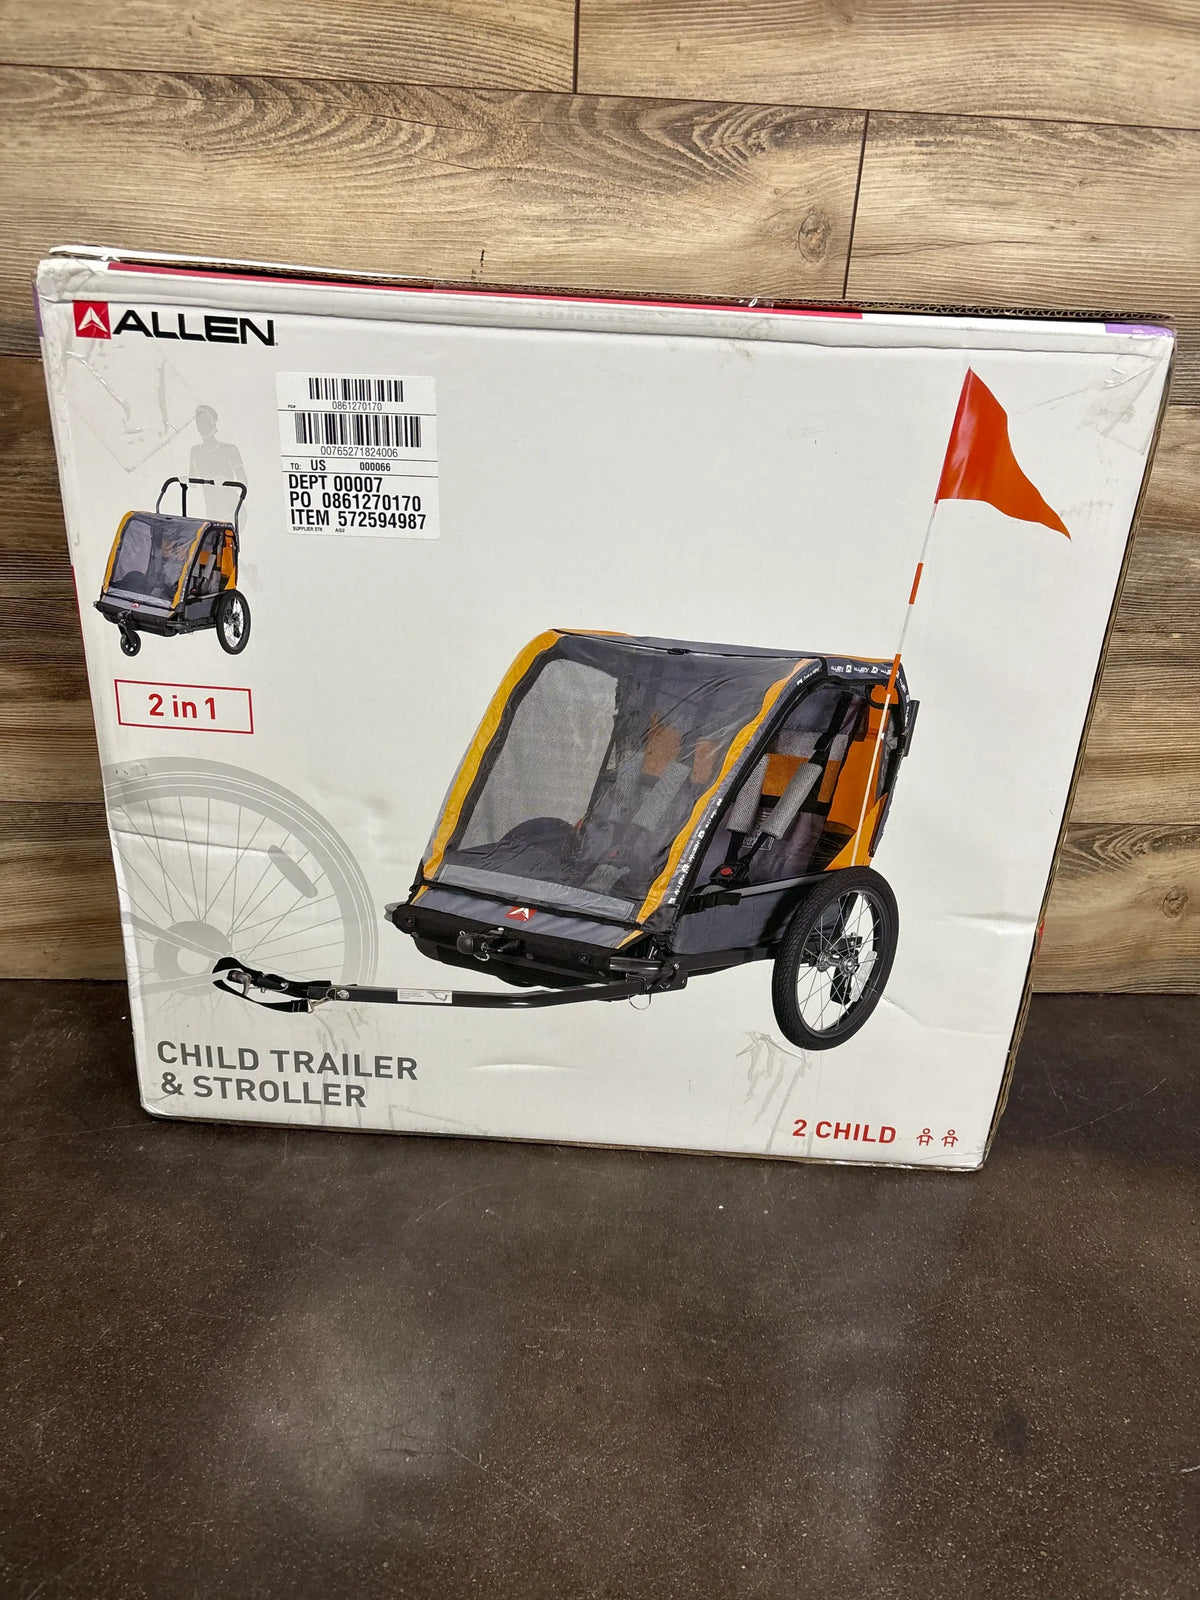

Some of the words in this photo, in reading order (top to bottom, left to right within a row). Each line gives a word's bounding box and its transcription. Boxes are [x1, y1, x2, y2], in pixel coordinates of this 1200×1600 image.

[112, 309, 275, 346] ALLEN
[332, 401, 382, 411] 0861270170
[320, 446, 398, 458] 00765271824006
[290, 462, 302, 470] TO:
[310, 459, 326, 471] US
[360, 462, 391, 472] 000066
[289, 474, 327, 490] DEPT
[333, 475, 383, 493] 00007
[290, 491, 311, 508] PO
[322, 492, 421, 512] 0861270170
[291, 509, 330, 526] ITEM
[338, 510, 426, 530] 572594987
[148, 693, 164, 717] 2
[172, 694, 197, 718] in
[204, 697, 216, 720] 1
[157, 1040, 259, 1071] CHILD
[269, 1049, 418, 1081] TRAILER
[161, 1071, 184, 1096] &
[193, 1075, 366, 1107] STROLLER
[792, 1119, 807, 1137] 2
[815, 1121, 896, 1144] CHILD
